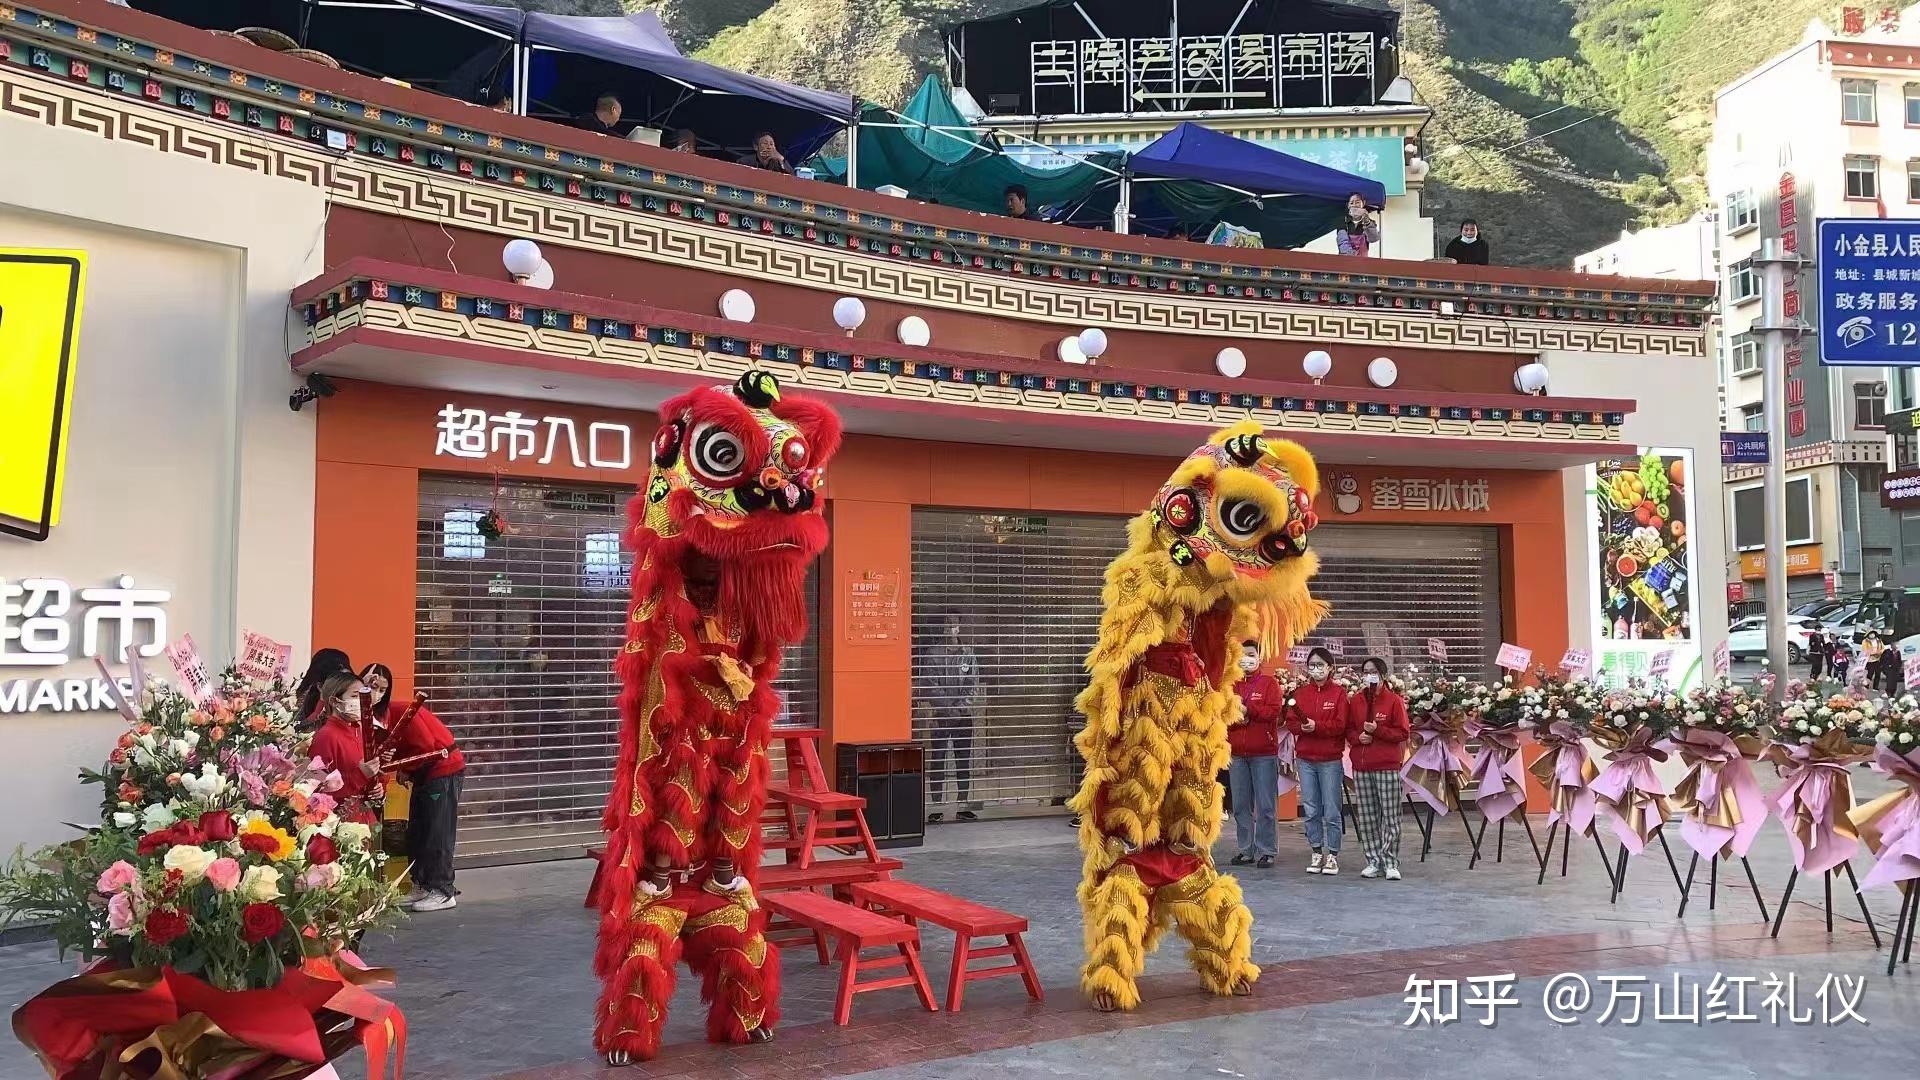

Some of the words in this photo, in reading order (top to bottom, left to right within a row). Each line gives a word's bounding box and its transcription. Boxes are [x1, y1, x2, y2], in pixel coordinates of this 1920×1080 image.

[1036, 31, 1373, 88] 土特产交易市场
[1835, 233, 1920, 257] 小金县人民
[1835, 291, 1918, 311] 政务服务
[1884, 322, 1917, 346] 12
[435, 403, 631, 469] 超市入口
[1736, 441, 1766, 450] 公共厕所
[1371, 477, 1490, 512] 蜜雪冰城
[0, 574, 172, 664] 超市
